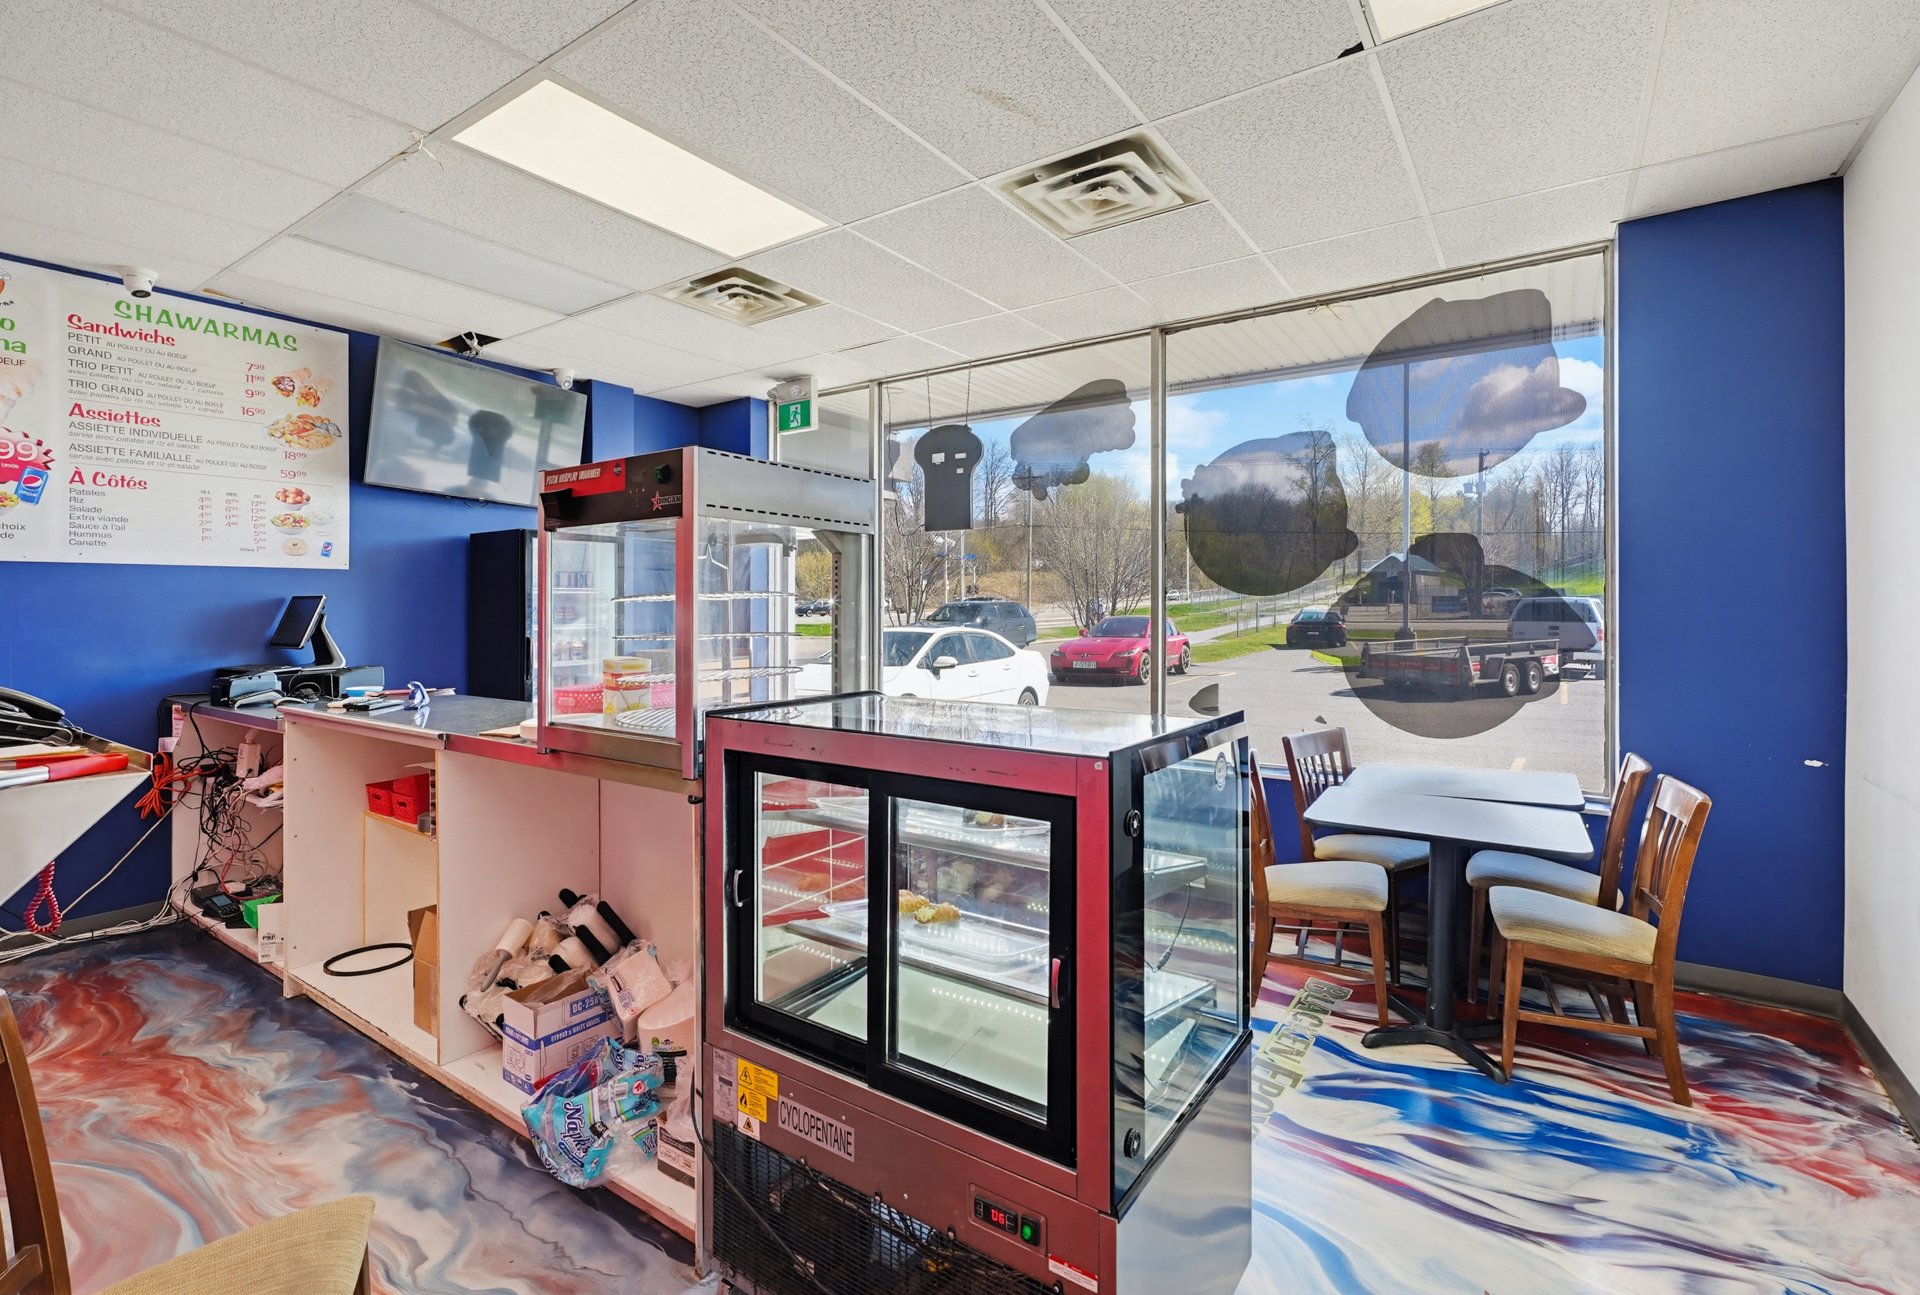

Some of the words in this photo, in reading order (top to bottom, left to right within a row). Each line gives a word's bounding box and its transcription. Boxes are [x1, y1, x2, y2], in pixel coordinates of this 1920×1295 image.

[67, 313, 176, 346] Sandwichs
[114, 300, 297, 351] SHAWARMAS
[68, 332, 102, 345] PETIT
[117, 342, 144, 352] POULET
[145, 347, 155, 355] OU
[167, 351, 188, 359] BOEUF
[67, 345, 112, 360] GRAND
[127, 357, 154, 367] POULET
[68, 358, 97, 371] TRIO
[101, 363, 134, 376] PETIT
[68, 378, 97, 390] TRIO
[101, 383, 144, 397] GRAND
[68, 402, 161, 427] Assiettes
[240, 406, 266, 417] 1699
[69, 421, 126, 435] ASSIETTE
[129, 427, 203, 444] INDIVIDUELLE
[216, 440, 239, 448] POULET
[69, 442, 126, 457] ASSIETTE
[129, 448, 192, 463] FAMILIALLE
[204, 458, 228, 467] POULET
[69, 466, 86, 486] À
[92, 471, 148, 490] Côtés
[280, 469, 307, 479] 5999
[69, 487, 106, 497] Patates
[69, 496, 85, 504] Riz
[69, 504, 103, 514] Salade
[69, 513, 95, 521] Extra
[97, 514, 129, 523] viande
[68, 521, 100, 530] Sauce
[69, 530, 113, 539] Hummus
[68, 538, 107, 547] Canette
[1251, 1056, 1304, 1141] EPO
[780, 1101, 853, 1157] CYCLOPENTANE
